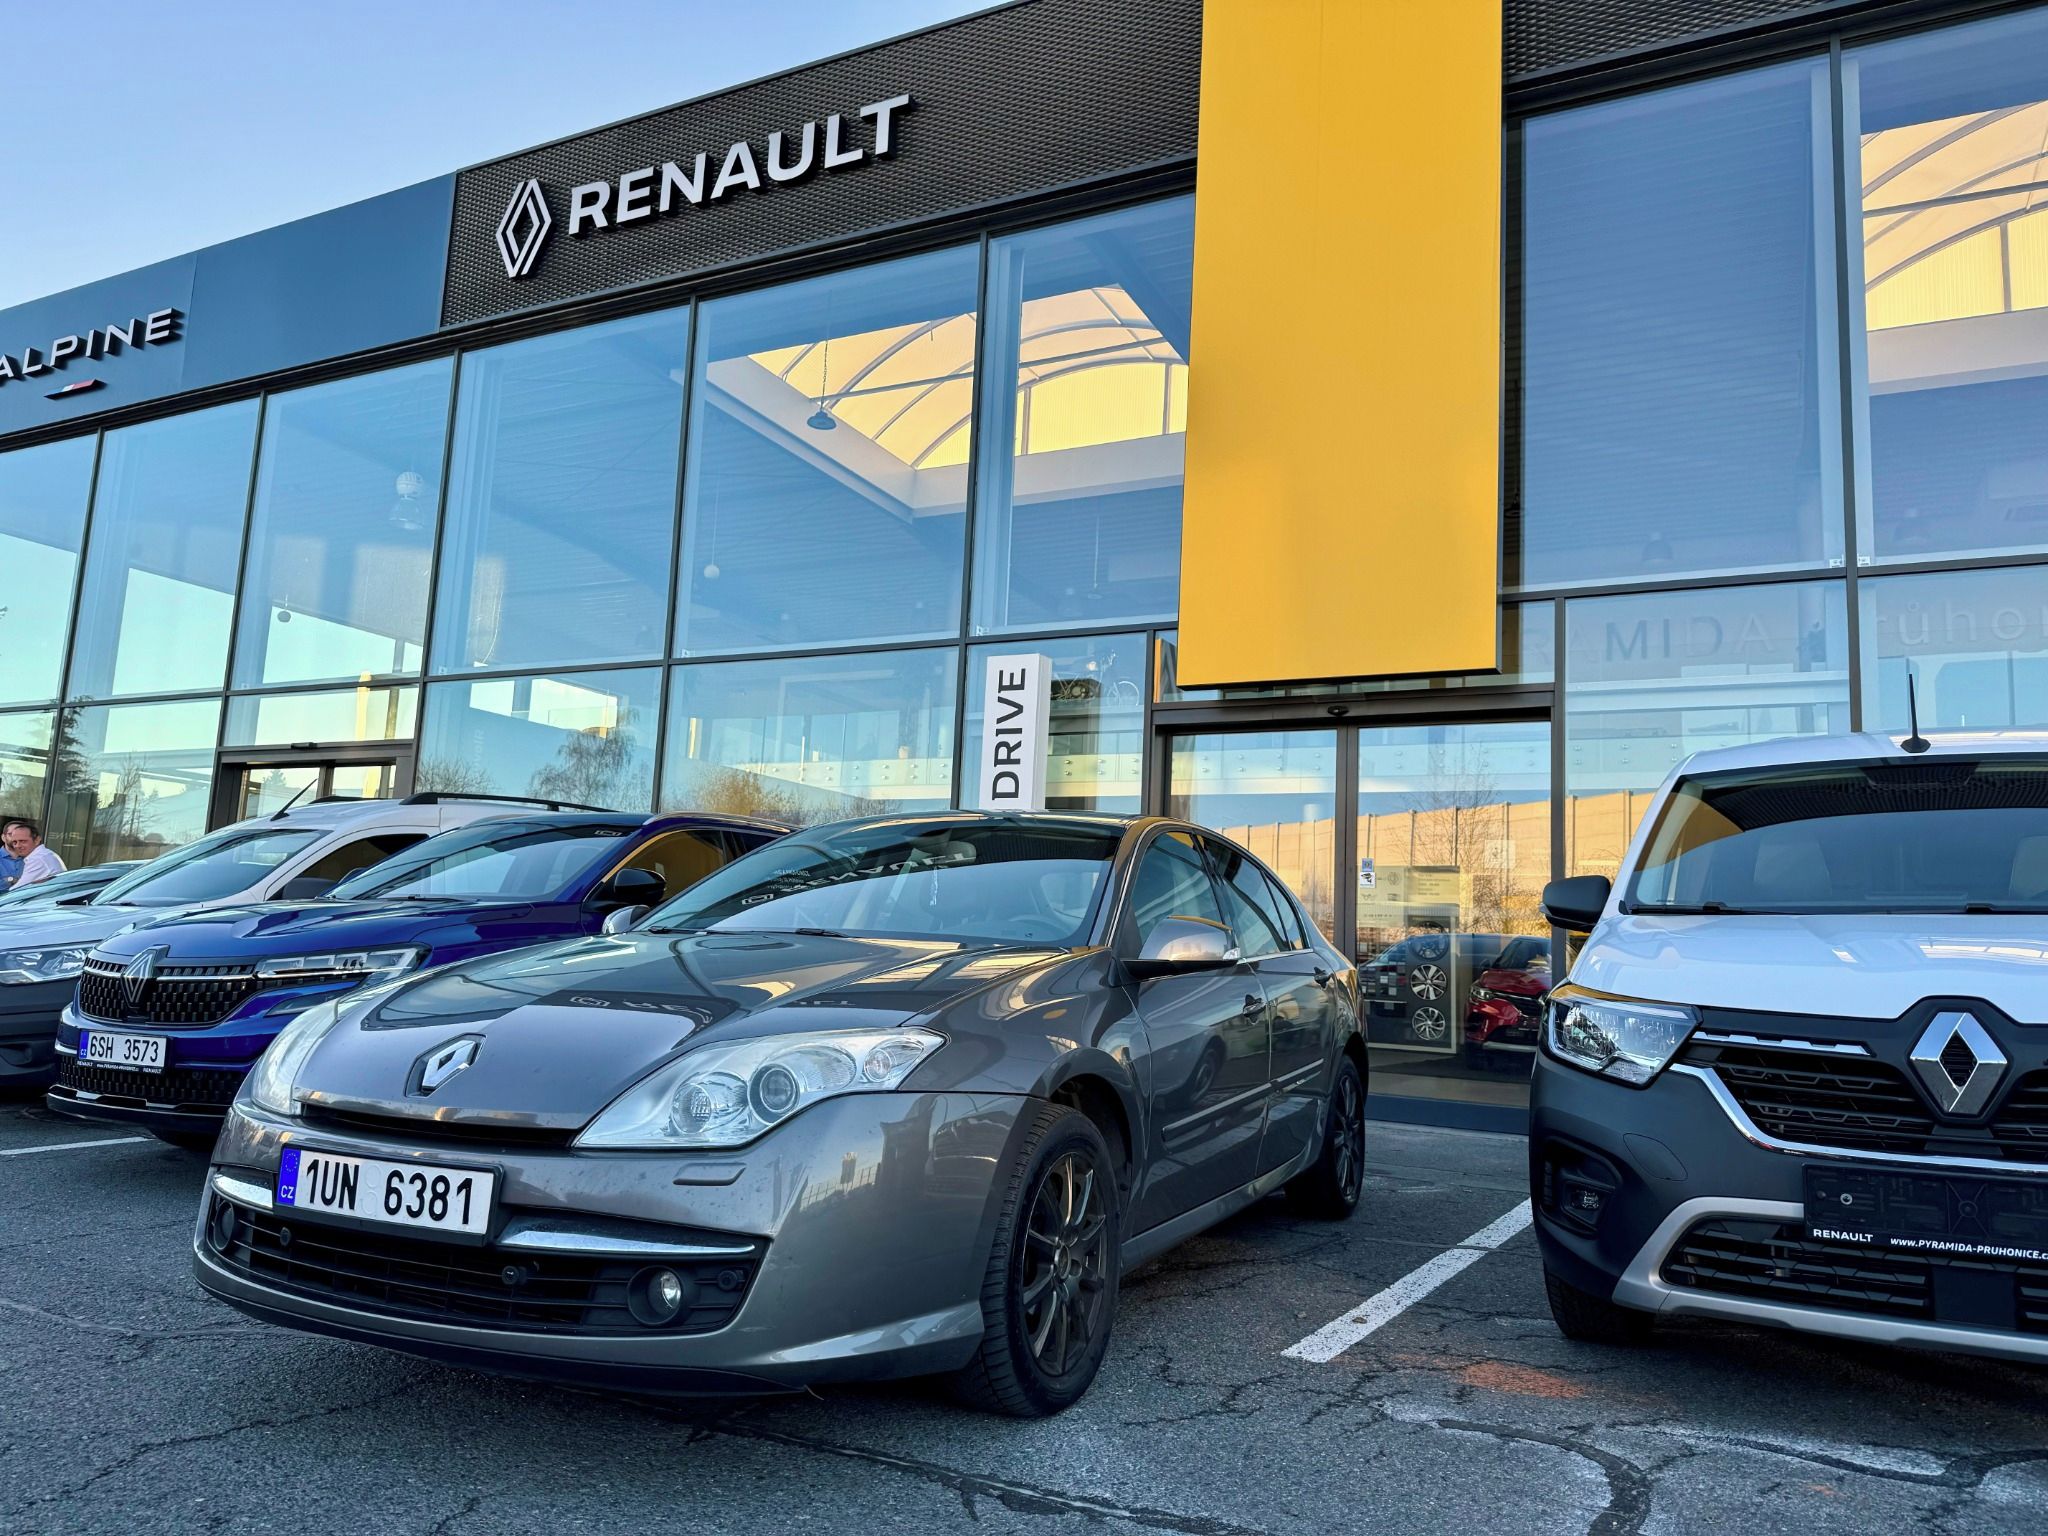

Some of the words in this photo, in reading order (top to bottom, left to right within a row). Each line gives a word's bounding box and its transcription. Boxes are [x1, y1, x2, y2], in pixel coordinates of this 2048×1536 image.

[568, 94, 910, 236] RENAULT
[0, 307, 174, 378] ALPINE
[991, 668, 1026, 801] DRIVE
[90, 1035, 114, 1059] 6SH
[123, 1038, 159, 1063] 3573
[280, 1184, 294, 1199] CZ
[306, 1158, 360, 1211] 1UN
[383, 1169, 473, 1225] 6381
[1812, 1228, 1874, 1243] RENAULT
